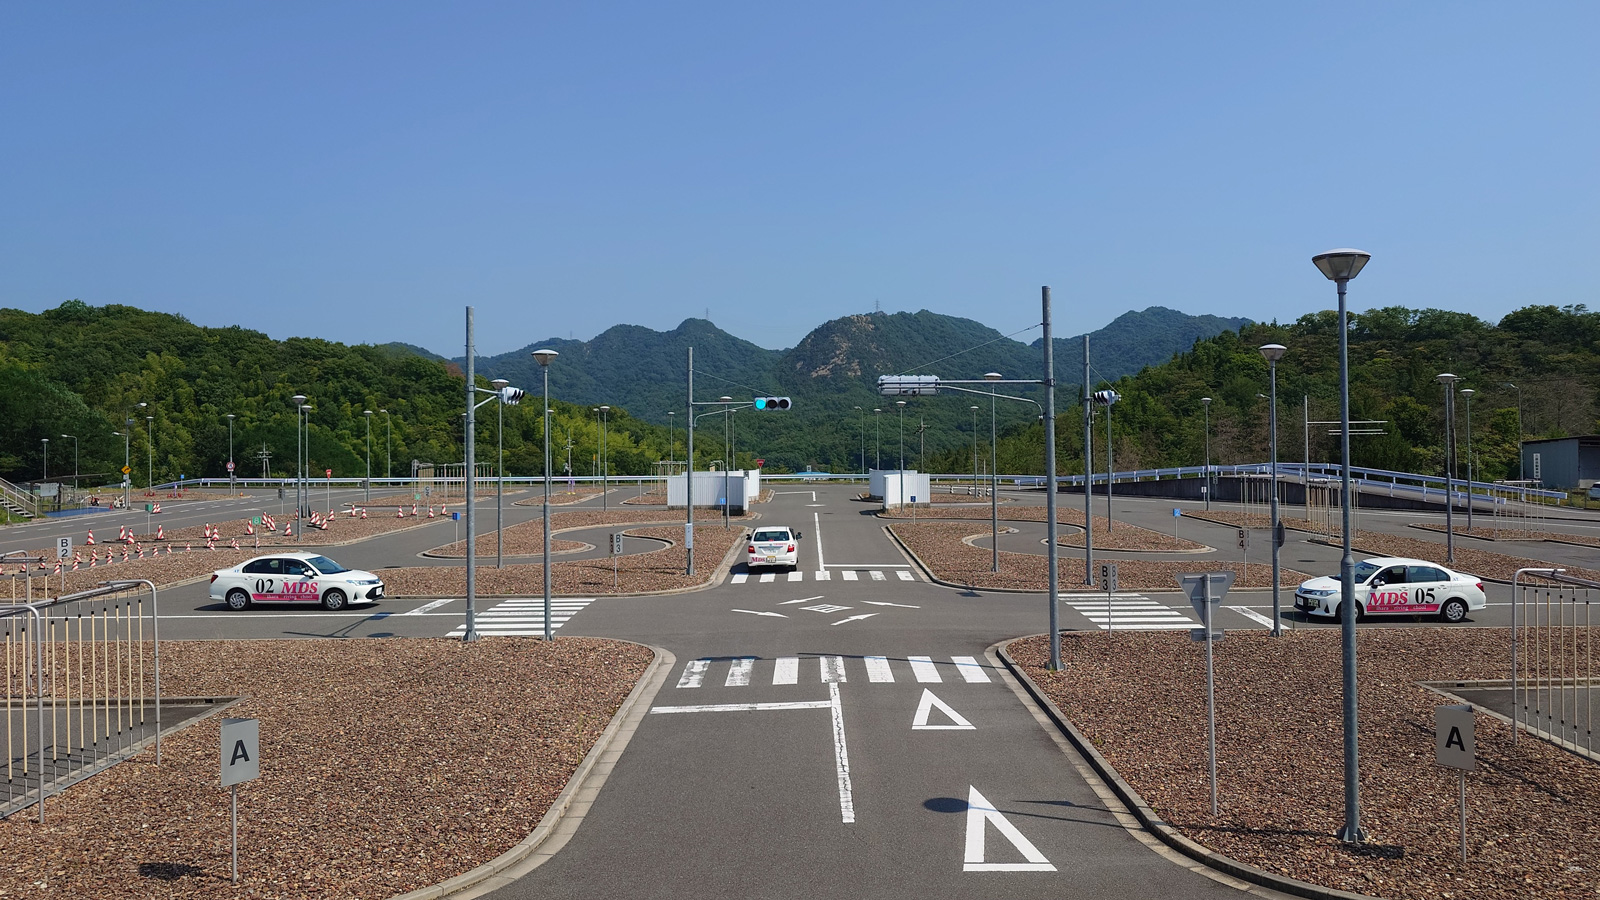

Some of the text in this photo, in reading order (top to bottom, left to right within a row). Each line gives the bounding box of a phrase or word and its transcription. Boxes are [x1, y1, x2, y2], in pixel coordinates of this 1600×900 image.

[616, 535, 621, 543] B
[1239, 530, 1244, 538] B
[61, 539, 68, 547] B
[616, 544, 621, 552] 3
[1239, 540, 1244, 548] 4
[61, 549, 68, 557] 2
[1102, 566, 1108, 577] B
[256, 579, 274, 593] 02
[281, 582, 318, 594] MDS
[1102, 579, 1108, 590] 3
[1368, 592, 1408, 605] MDS
[1415, 588, 1435, 604] 05
[1445, 726, 1465, 751] A
[230, 740, 250, 766] A
